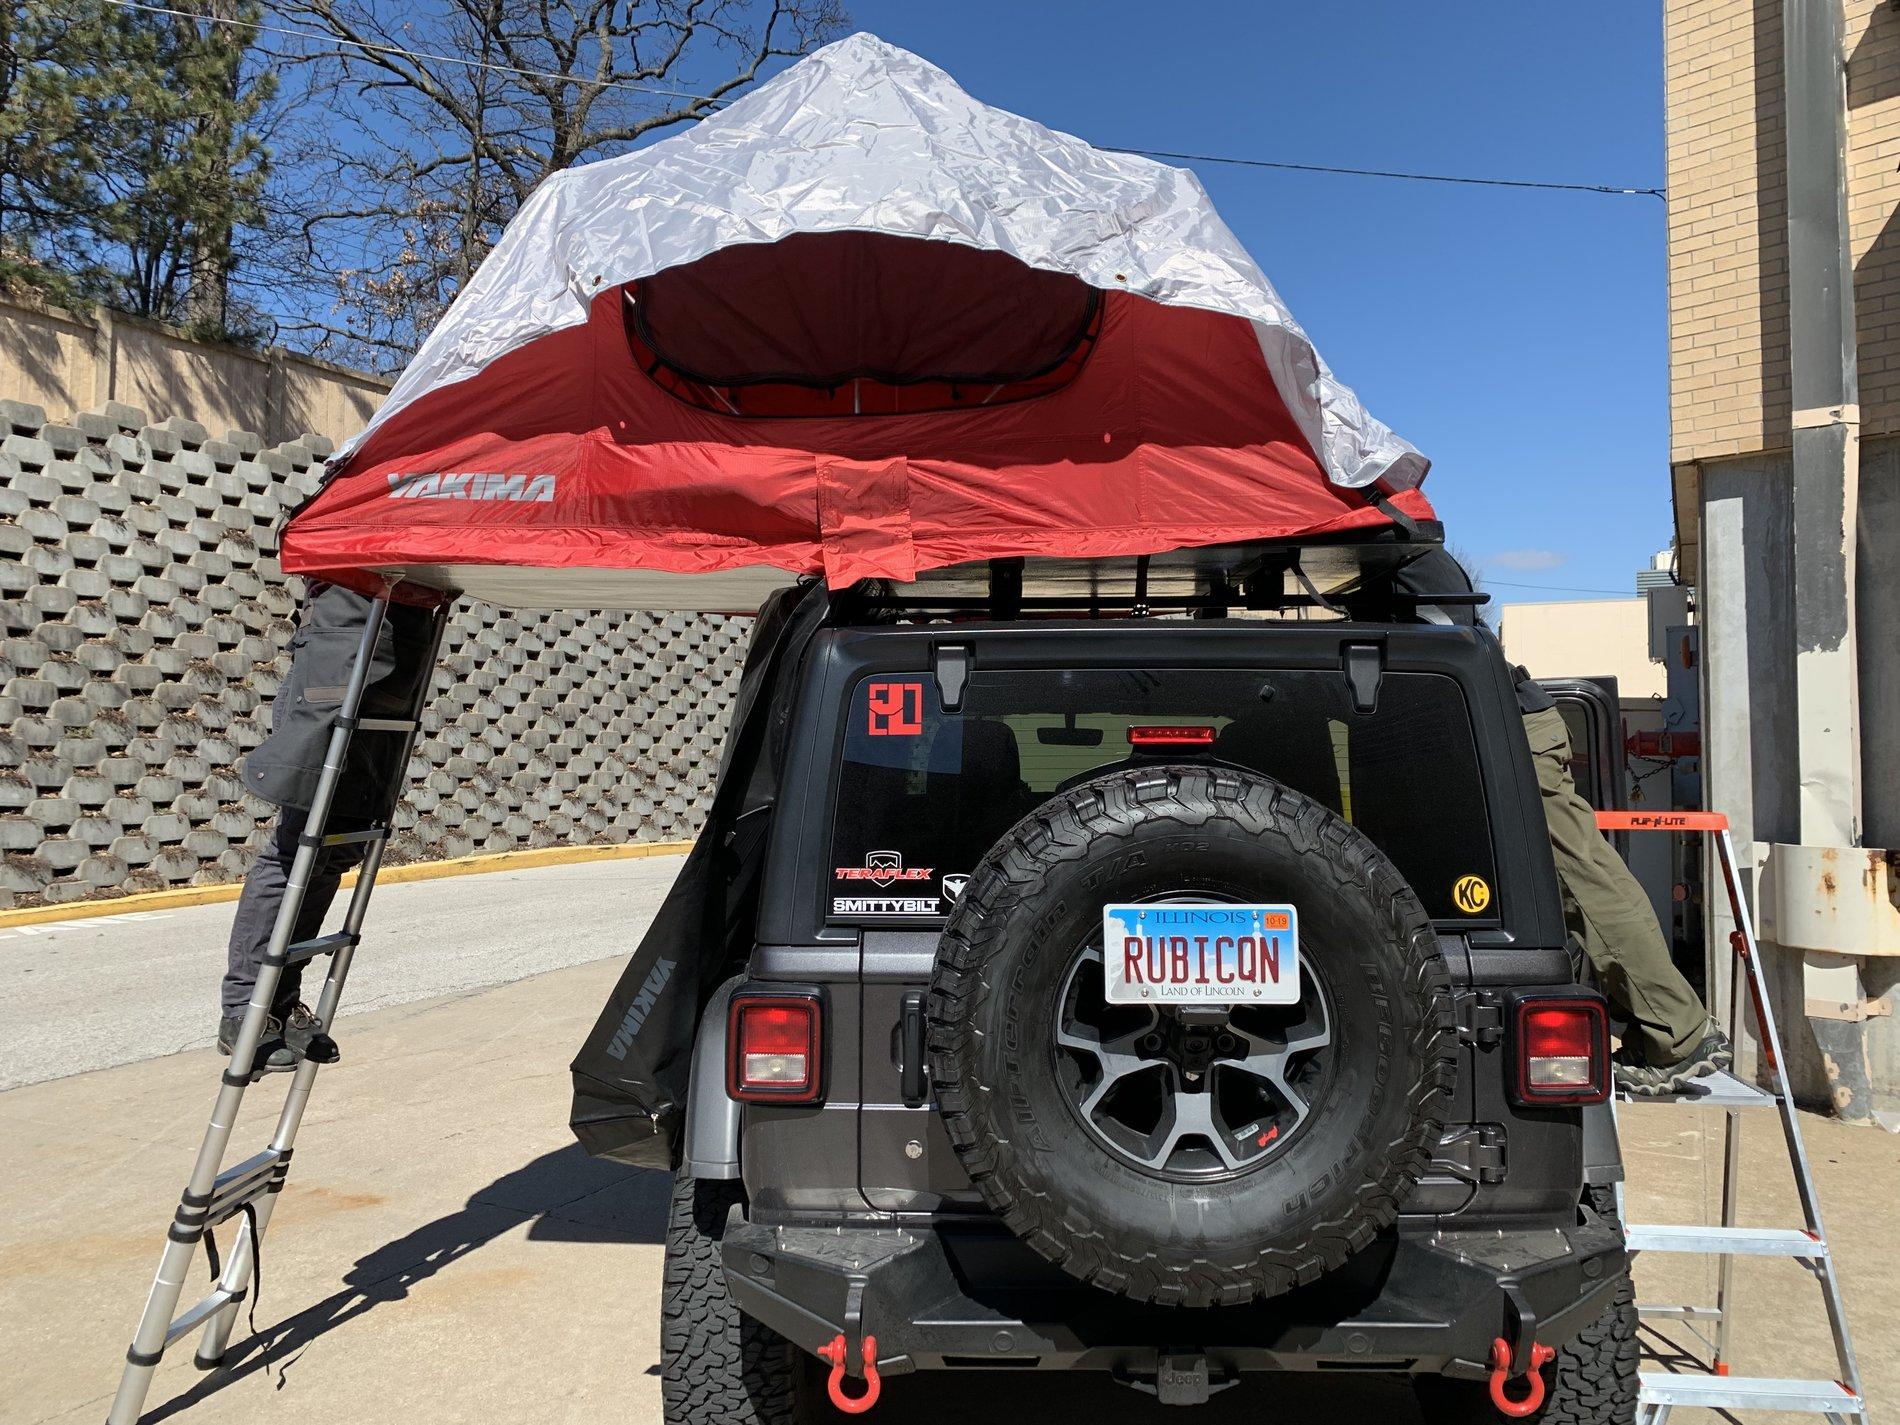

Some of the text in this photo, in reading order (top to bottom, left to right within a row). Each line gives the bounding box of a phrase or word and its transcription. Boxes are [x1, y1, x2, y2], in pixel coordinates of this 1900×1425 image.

[387, 473, 556, 502] YAKIMA
[835, 867, 935, 880] TERAFLEX
[833, 900, 940, 912] SMITTYBILT
[1458, 878, 1485, 910] KC
[1156, 911, 1247, 924] ILLINOIS
[1124, 936, 1280, 984] RUBICQN
[606, 956, 678, 1061] YAKIMA
